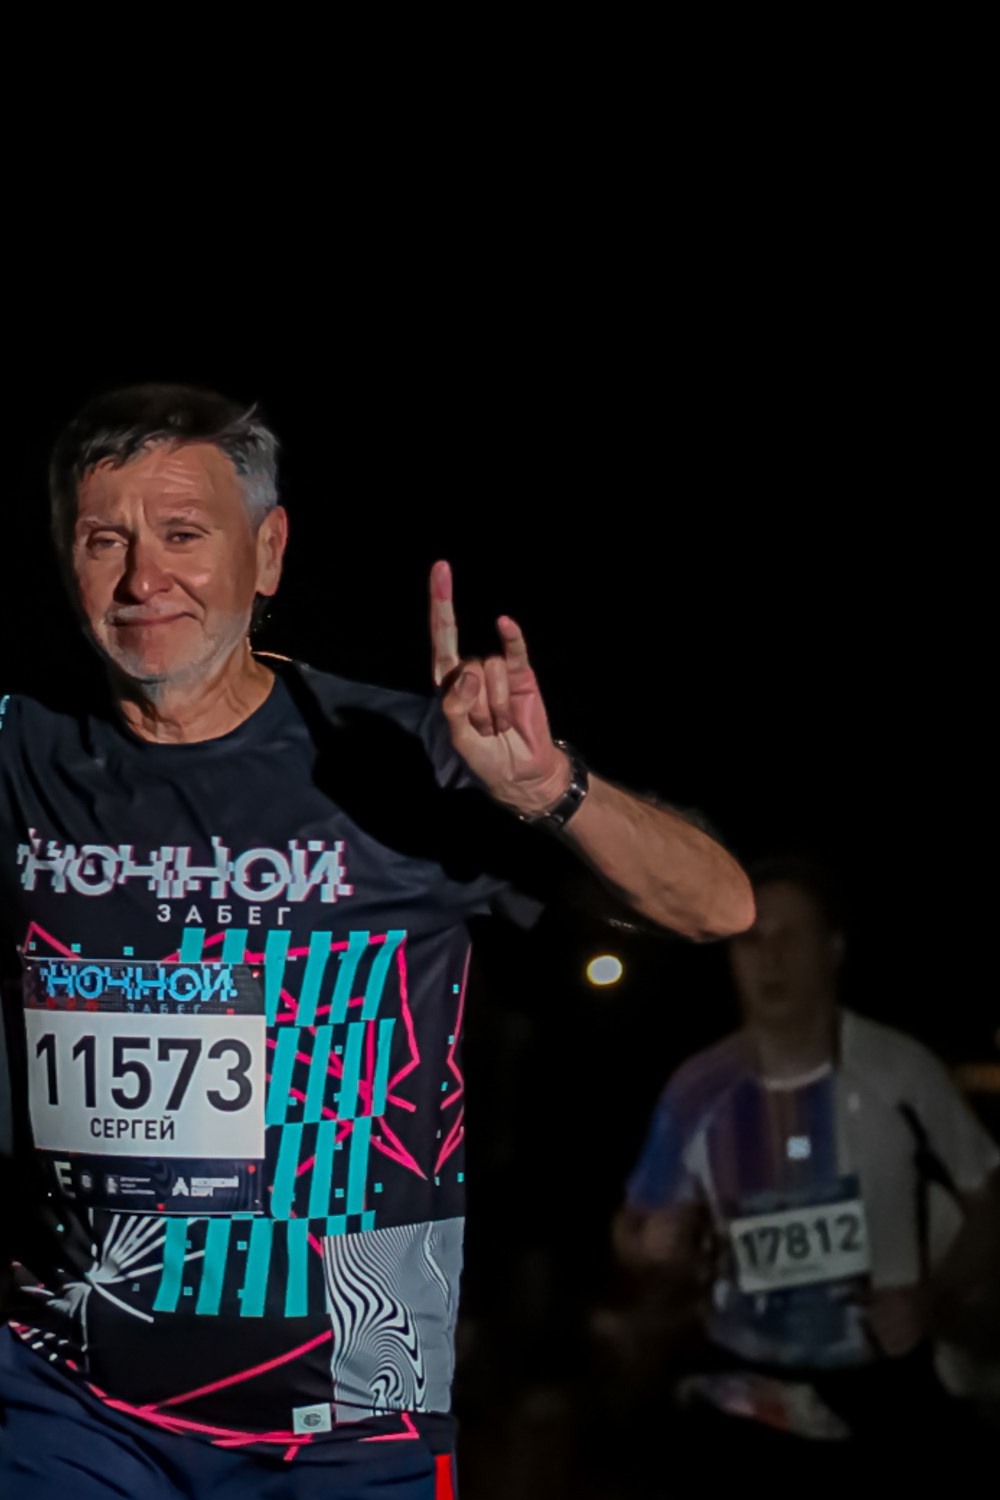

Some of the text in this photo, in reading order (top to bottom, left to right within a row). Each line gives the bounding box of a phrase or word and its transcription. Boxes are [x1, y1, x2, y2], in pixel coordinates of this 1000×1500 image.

[156, 904, 291, 926] ЗАБЕГ
[36, 1034, 253, 1113] 11573
[90, 1115, 175, 1140] СЕРГЕЙ
[739, 1213, 864, 1270] 17812
